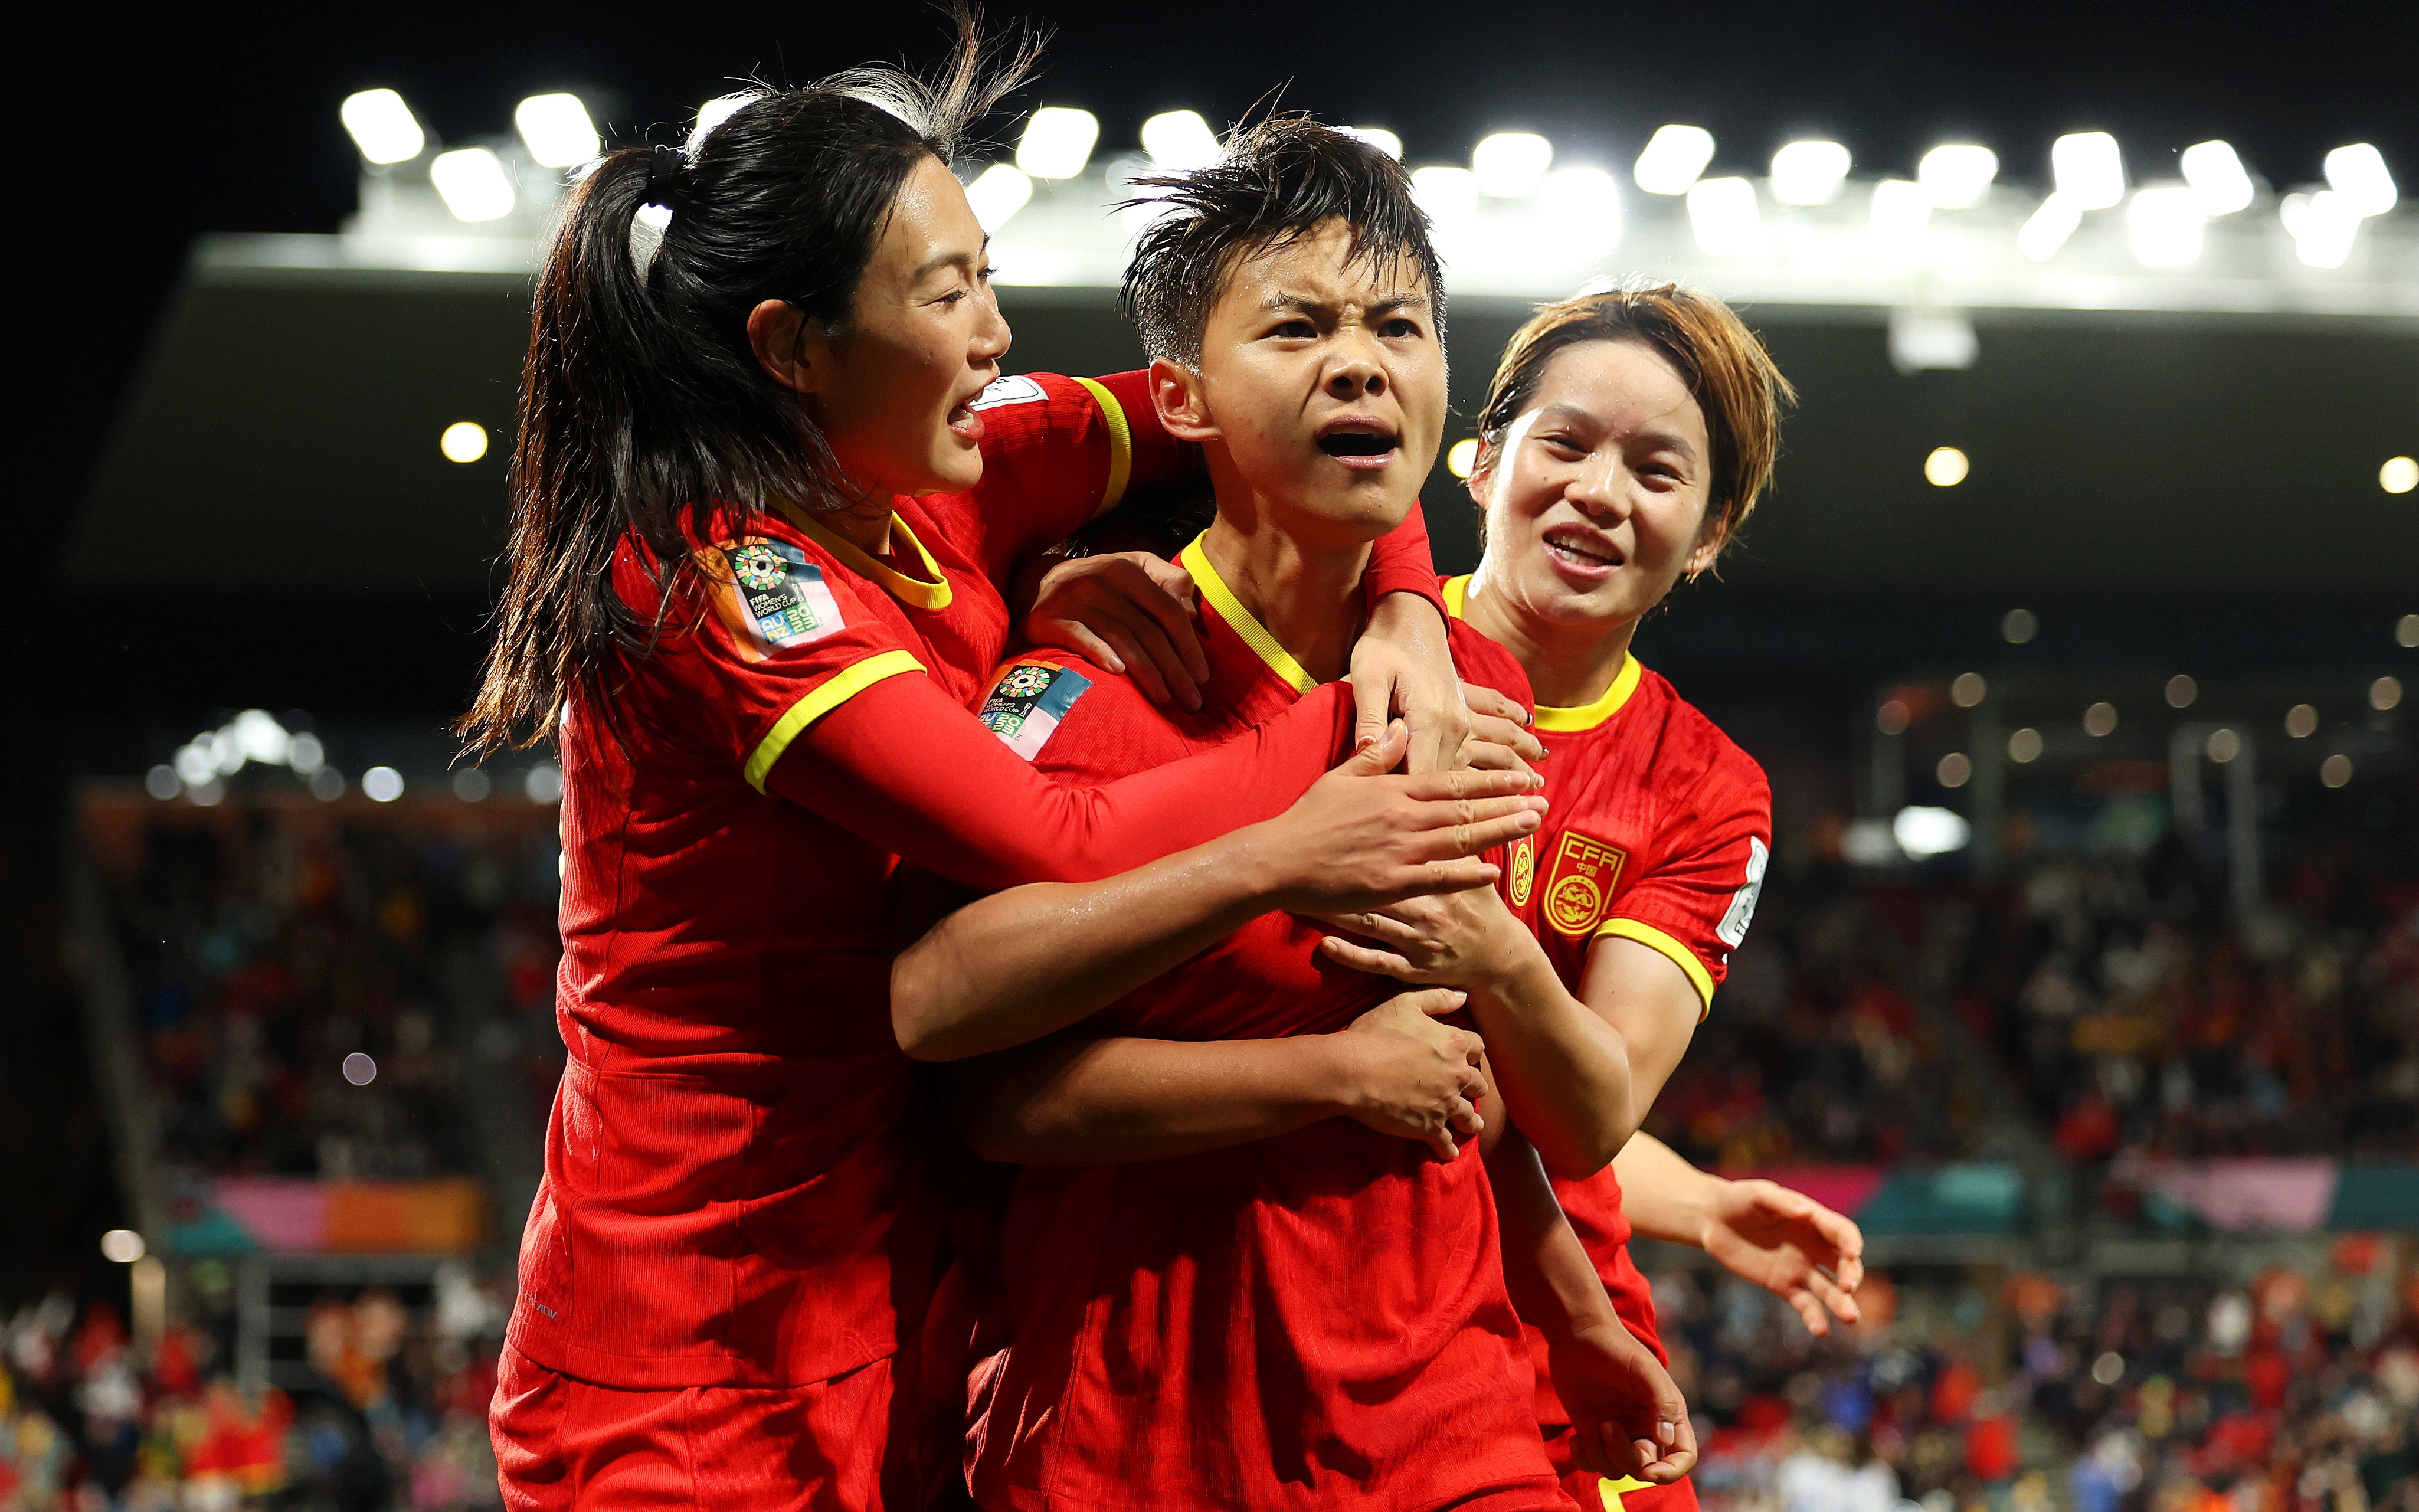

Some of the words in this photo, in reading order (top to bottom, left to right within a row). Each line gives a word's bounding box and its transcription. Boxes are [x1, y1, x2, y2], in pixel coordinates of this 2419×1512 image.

[749, 594, 769, 606] FIFA
[753, 594, 788, 611] WOMEN'S
[755, 603, 782, 617] WORLD
[782, 597, 796, 607] CUP
[762, 614, 785, 631] AU
[766, 626, 791, 642] NZ
[1564, 839, 1619, 872] CFA
[1576, 862, 1598, 878] 中国
